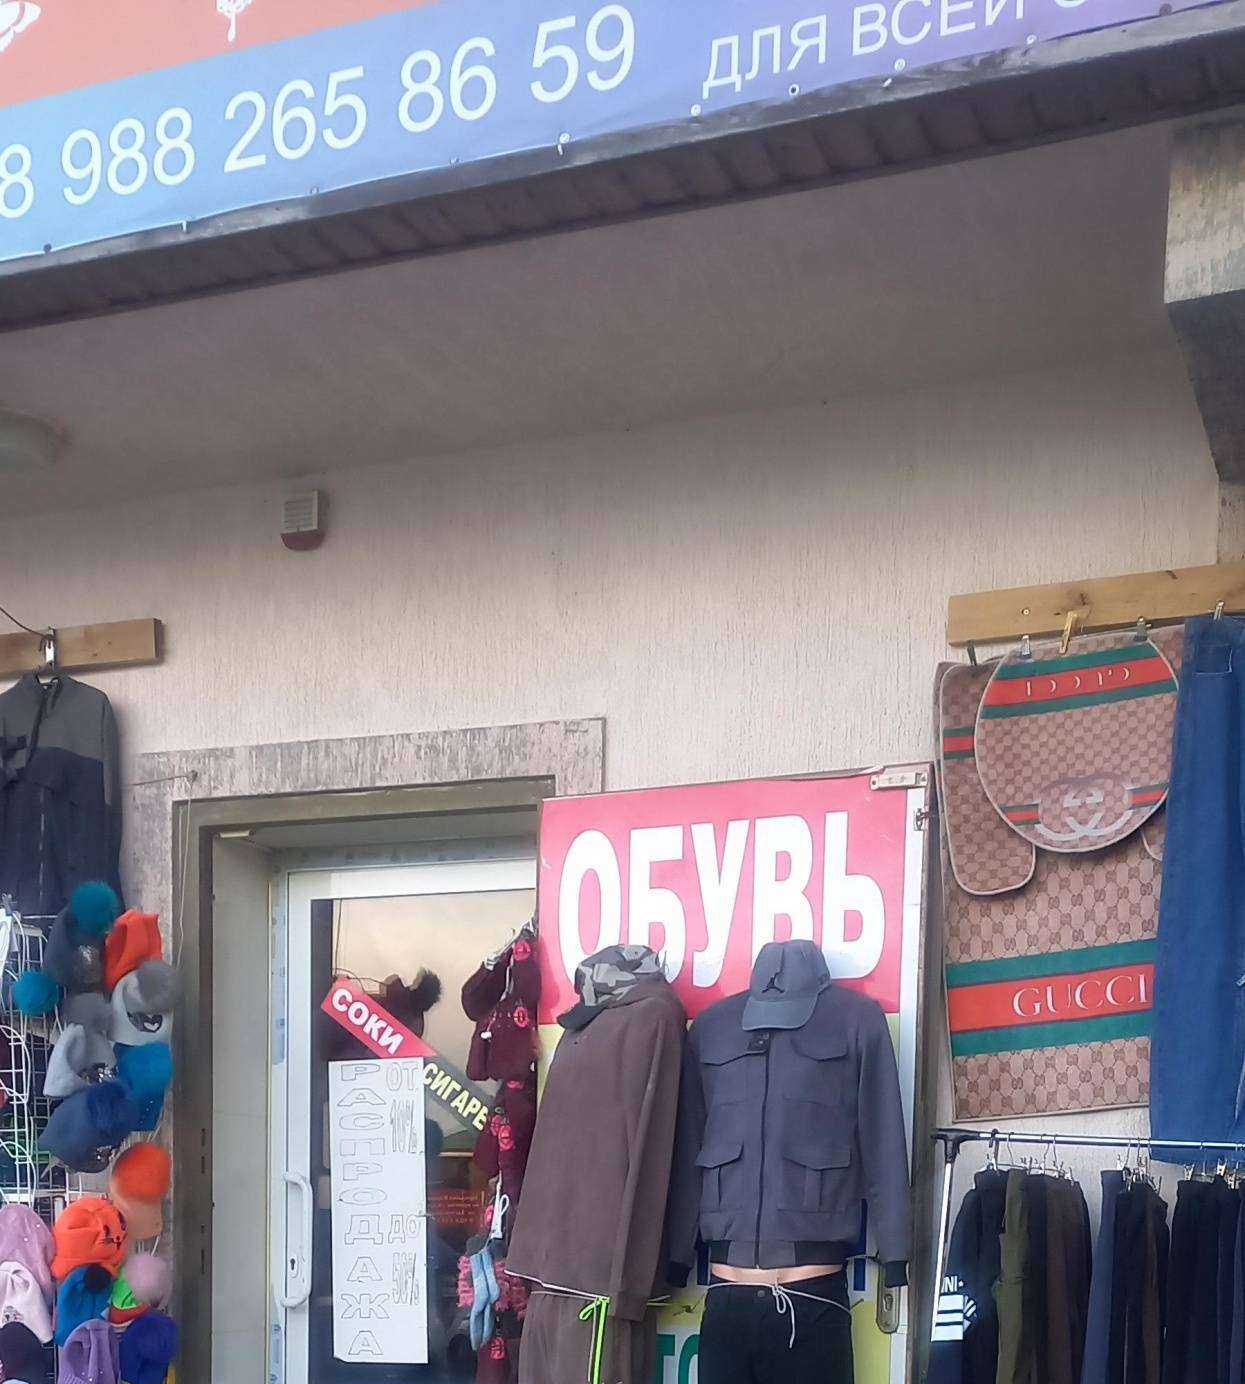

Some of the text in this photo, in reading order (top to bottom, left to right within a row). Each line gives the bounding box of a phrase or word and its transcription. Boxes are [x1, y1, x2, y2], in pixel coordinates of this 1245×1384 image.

[702, 14, 827, 100] ДЛЯ
[0, 4, 636, 218] 8 988 265 86 59
[558, 811, 886, 988] ОБУВЬ
[332, 988, 405, 1056] СОКИ
[1012, 973, 1148, 1018] GUCCI
[386, 1061, 419, 1092] ОТ
[388, 1214, 421, 1244] ДО
[392, 1251, 420, 1306] 50%
